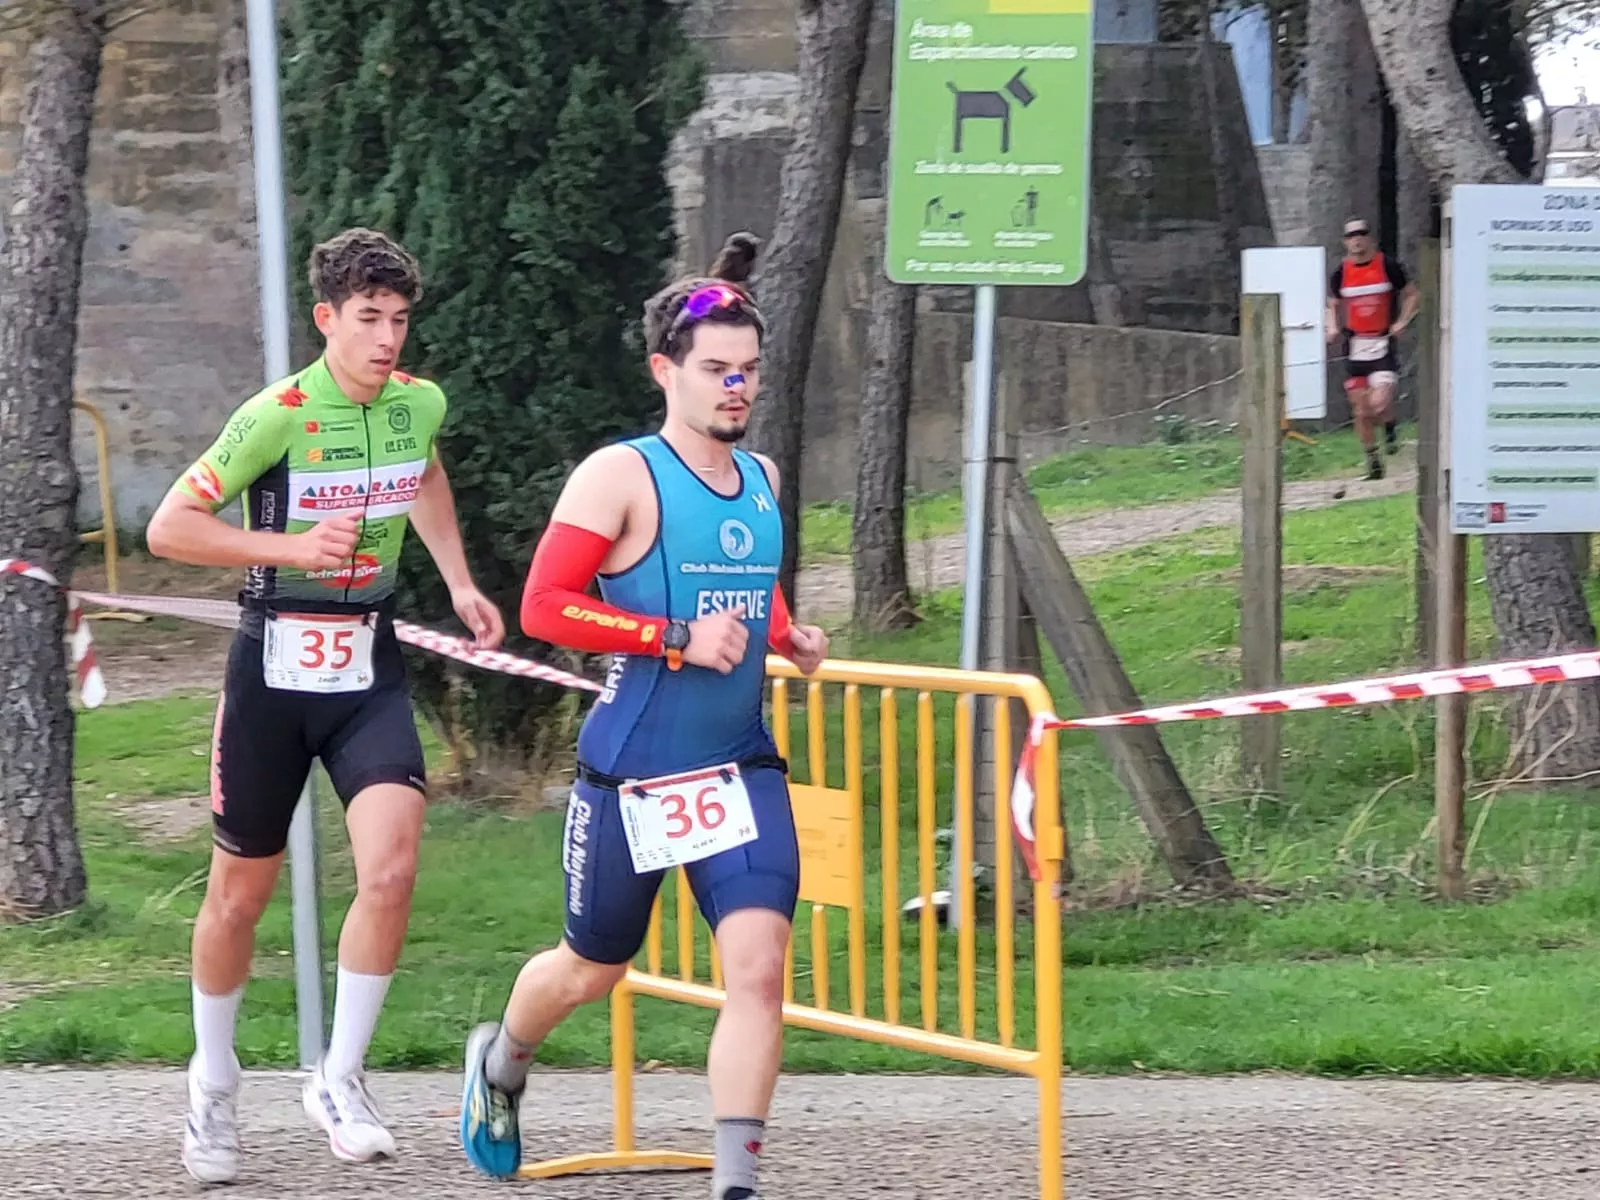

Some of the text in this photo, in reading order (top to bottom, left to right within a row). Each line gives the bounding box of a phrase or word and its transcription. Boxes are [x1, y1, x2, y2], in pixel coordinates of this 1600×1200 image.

[301, 471, 418, 498] ALTOARAGÓ
[697, 590, 766, 620] ESTEVE
[299, 629, 354, 670] 35
[572, 800, 592, 844] Club
[660, 786, 727, 839] 36
